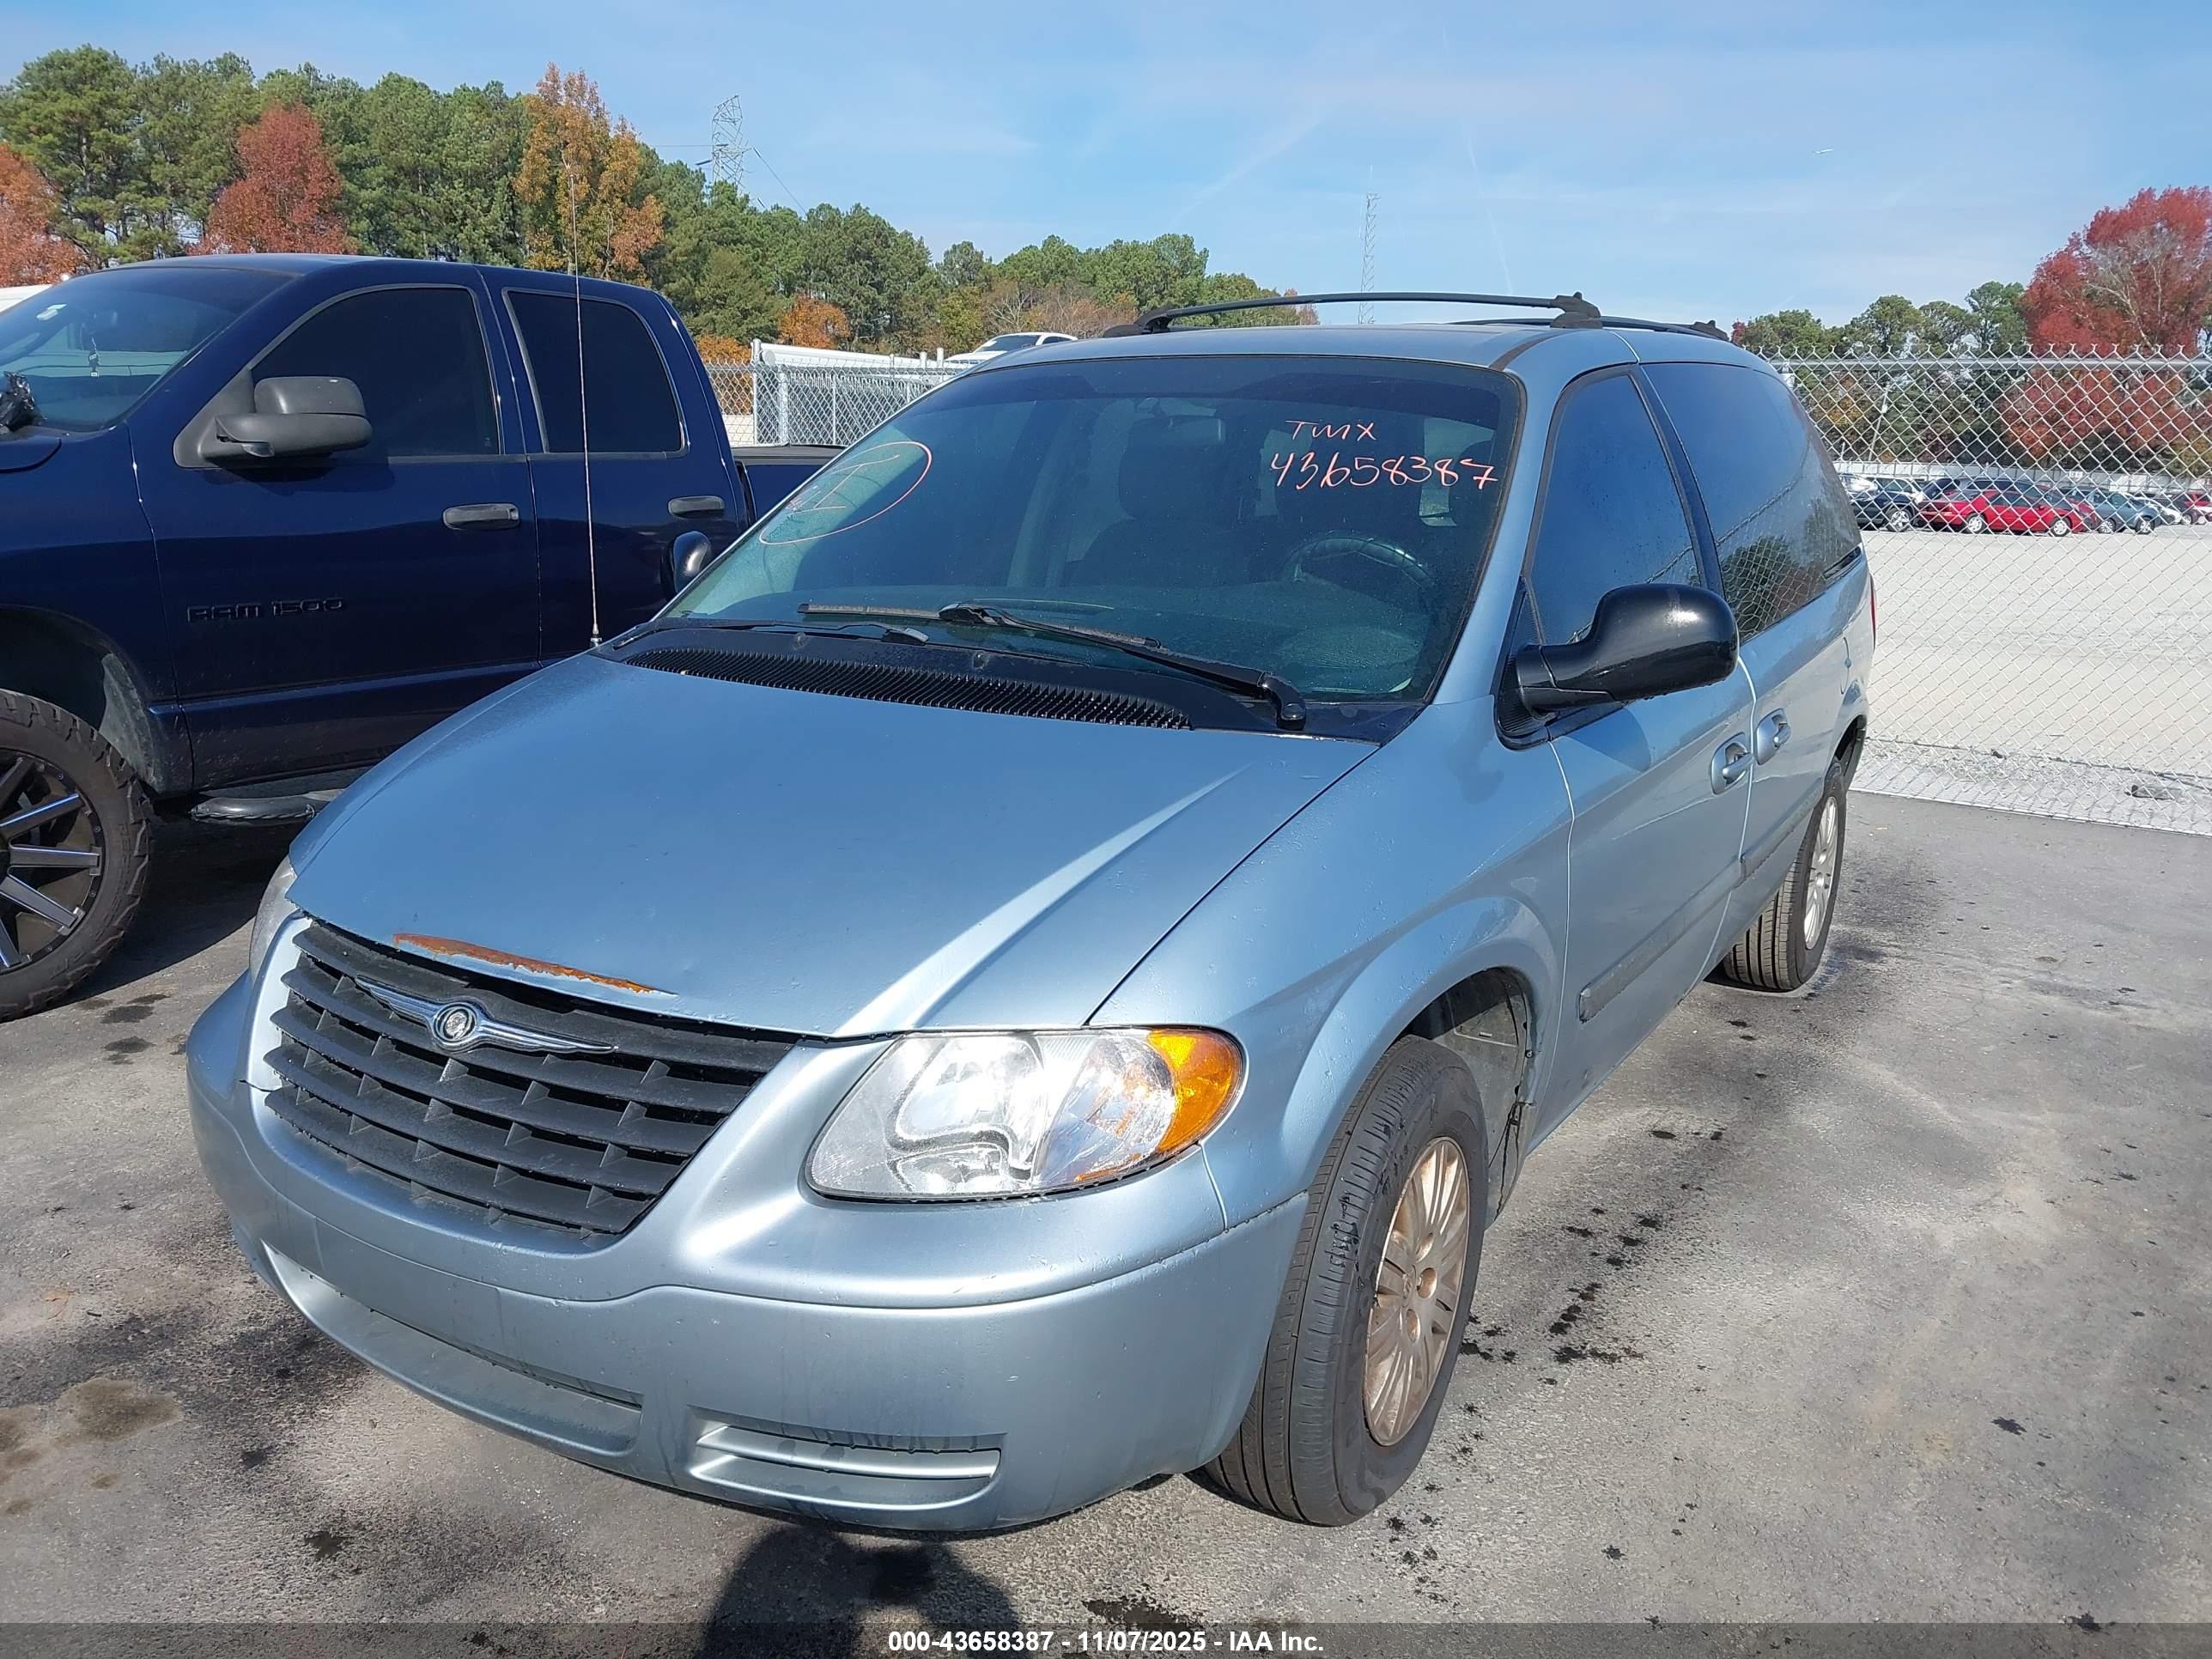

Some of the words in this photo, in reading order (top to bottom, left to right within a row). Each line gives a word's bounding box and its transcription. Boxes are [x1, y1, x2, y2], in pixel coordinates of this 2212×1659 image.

[1270, 452, 1498, 489] 43658387
[186, 604, 261, 622] RAM
[270, 597, 343, 616] 1500
